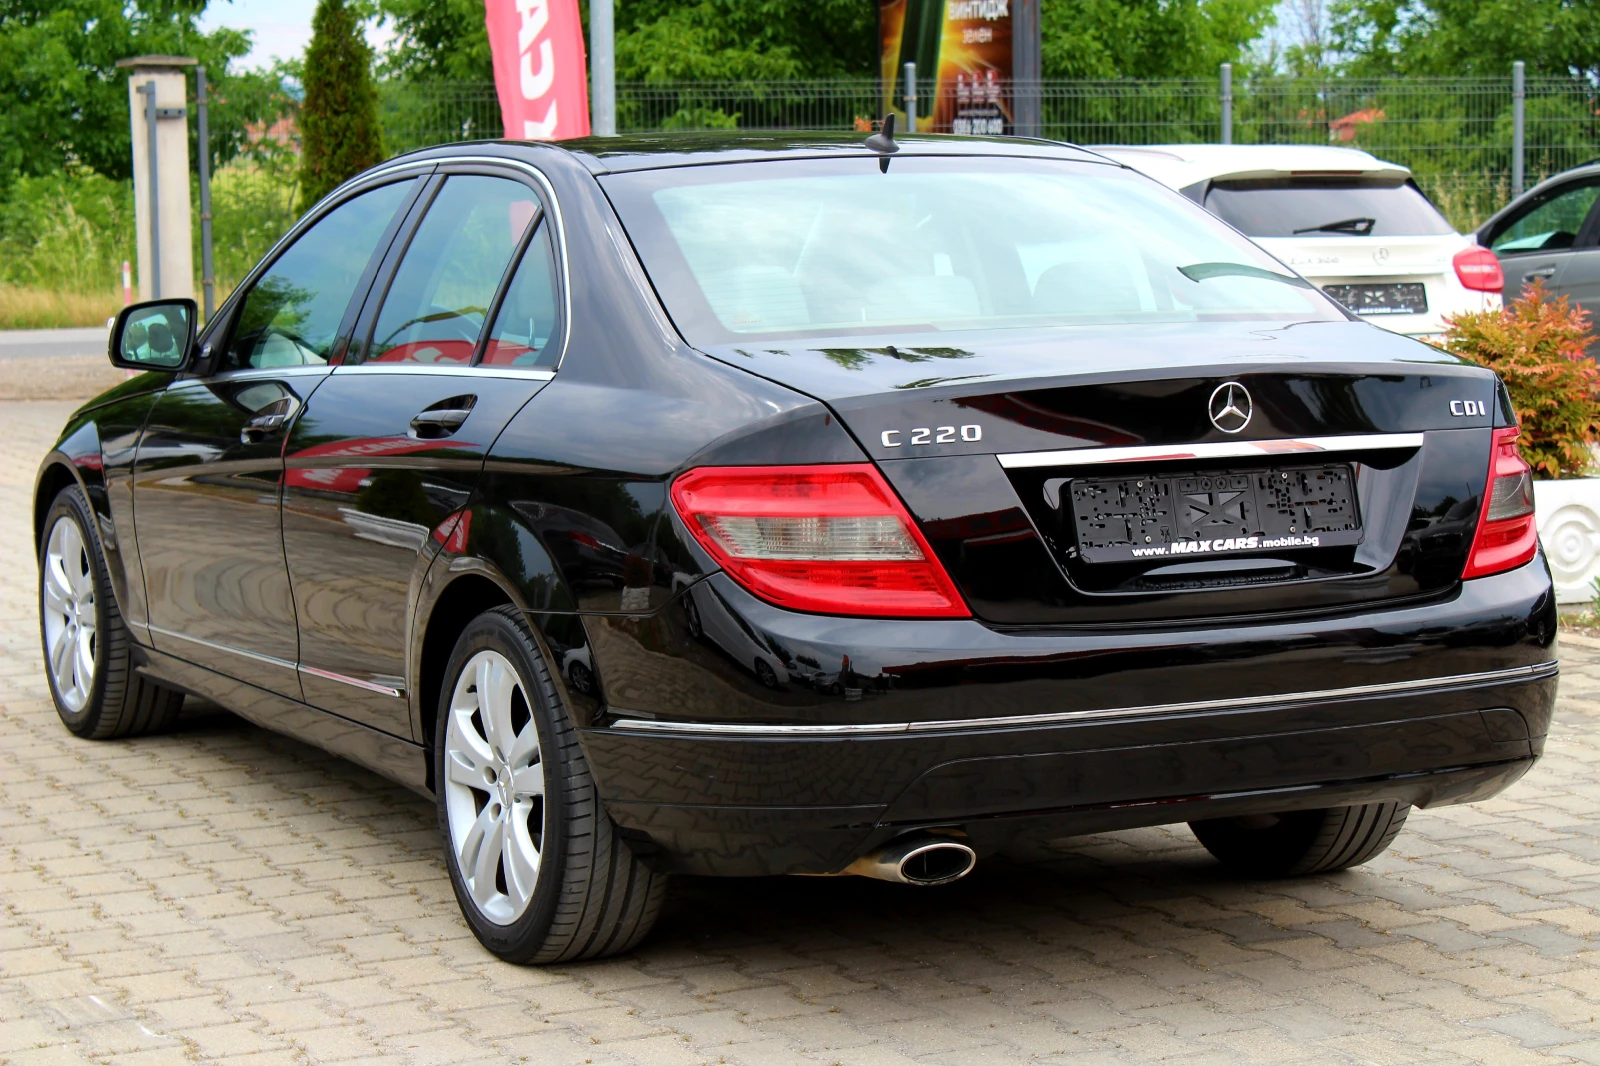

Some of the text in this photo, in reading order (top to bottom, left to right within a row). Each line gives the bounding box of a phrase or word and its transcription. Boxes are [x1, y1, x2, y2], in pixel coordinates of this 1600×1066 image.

[1449, 400, 1486, 416] CDI
[881, 424, 983, 447] C 220
